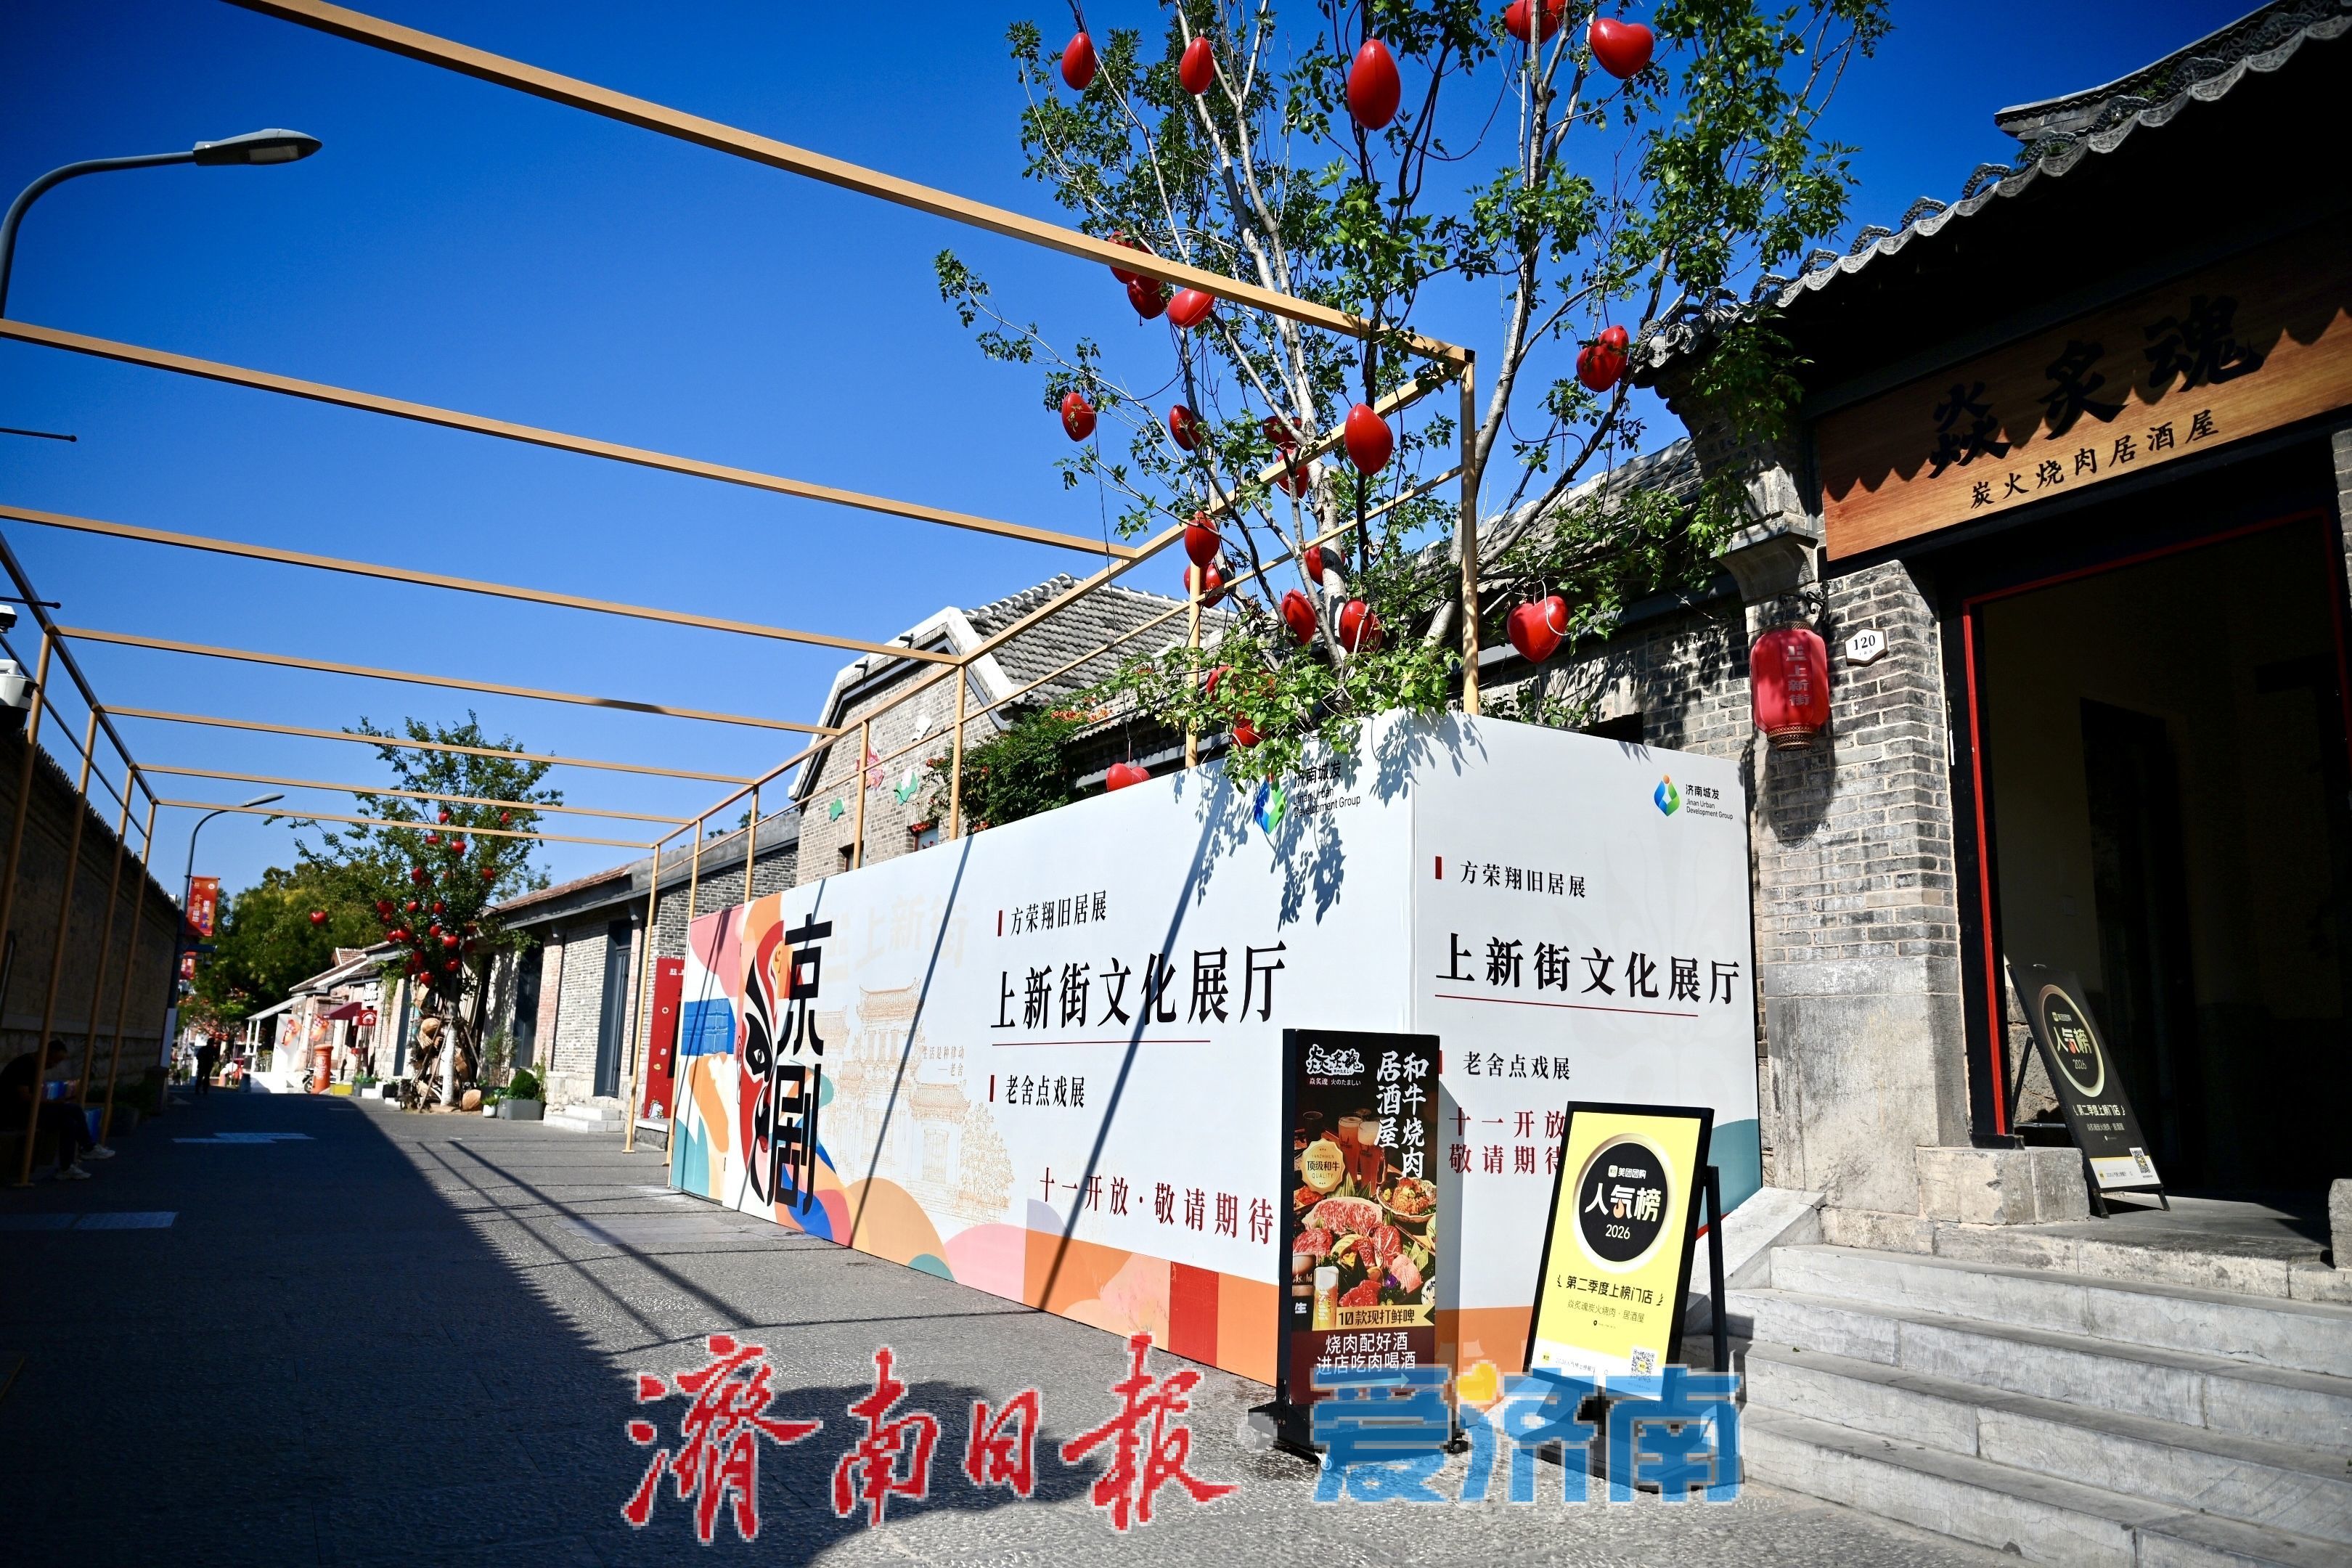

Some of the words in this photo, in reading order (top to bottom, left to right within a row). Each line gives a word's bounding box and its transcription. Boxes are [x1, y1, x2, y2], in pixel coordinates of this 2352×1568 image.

[1927, 295, 2263, 478] 焱炙魂
[1970, 409, 2219, 509] 炭火烧肉居酒屋
[1854, 635, 1875, 650] 120
[1294, 759, 1342, 788] 济南城发
[1294, 792, 1312, 805] Jinan
[1313, 788, 1334, 799] Urban
[1686, 784, 1719, 800] 济南城发
[1294, 799, 1338, 818] Development
[1339, 795, 1361, 808] Group
[1686, 807, 1718, 817] Development
[1718, 811, 1734, 820] Group
[1460, 860, 1586, 899] 方荣翔旧居展
[1010, 890, 1107, 936] 方荣翔旧居展
[1436, 932, 1739, 1005] 上新街文化展厅
[991, 940, 1287, 1029] 上新街文化展厅
[922, 1045, 965, 1060] 生活是种律动
[2053, 1026, 2092, 1053] 人气榜
[767, 913, 833, 1216] 京剧
[1463, 1051, 1570, 1080] 老舍点戏展
[2073, 1059, 2087, 1069] 2026
[1005, 1074, 1085, 1108] 老舍点戏展
[1374, 1050, 1402, 1149] 居酒屋
[1401, 1052, 1429, 1178] 和牛烧肉
[1449, 1107, 1565, 1138] 十一开放
[2077, 1104, 2121, 1116] 第二季度上榜门店
[1307, 1161, 1340, 1172] 顶级和牛
[1618, 1167, 1646, 1179] 美团团购
[1585, 1183, 1662, 1222] 人气榜
[1605, 1224, 1630, 1240] 2026
[1566, 1275, 1653, 1304] 第二季度上榜门店
[1294, 1302, 1307, 1315] 生
[1339, 1308, 1415, 1326] 10款现打鲜啤
[1325, 1331, 1408, 1355] 烧肉配好酒
[1316, 1351, 1416, 1376] 进店吃肉喝酒
